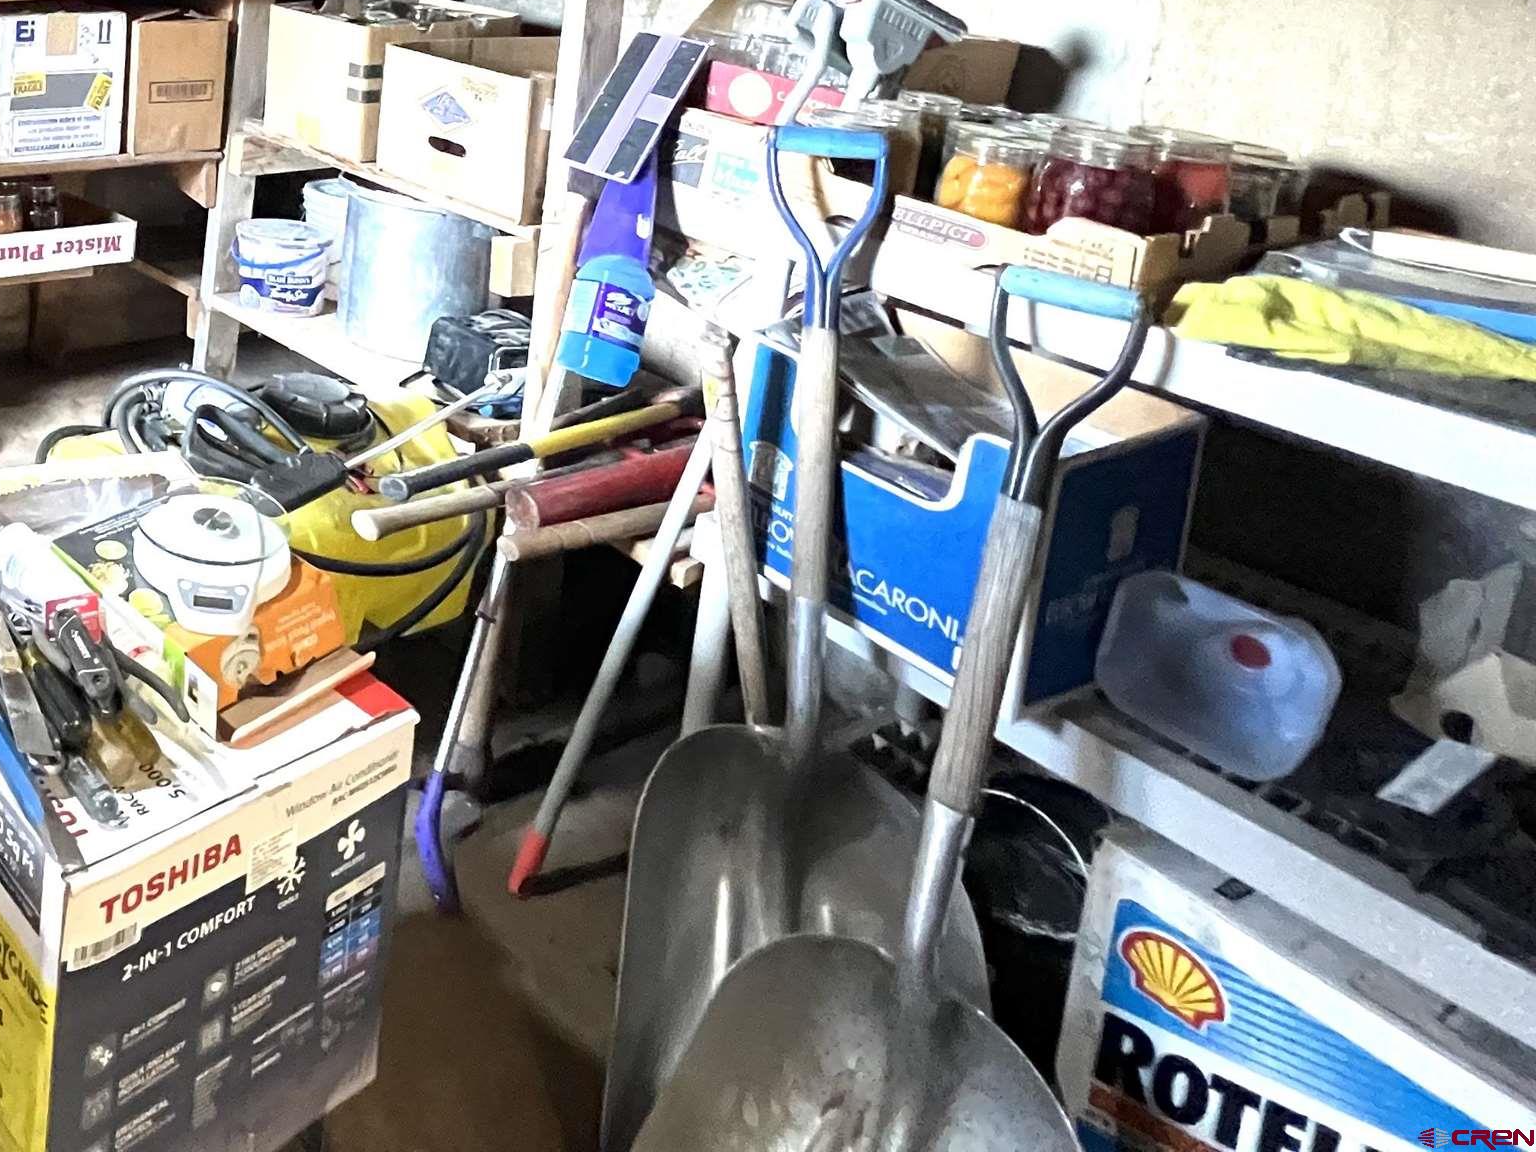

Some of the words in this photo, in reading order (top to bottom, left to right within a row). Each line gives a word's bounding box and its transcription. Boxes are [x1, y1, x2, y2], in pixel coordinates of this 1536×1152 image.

[52, 235, 122, 255] Mister
[849, 562, 960, 642] CARONI
[285, 791, 328, 818] Window
[99, 834, 242, 924] TOSHIBA
[121, 941, 172, 983] 2-IN-1
[177, 895, 256, 950] COMFORT
